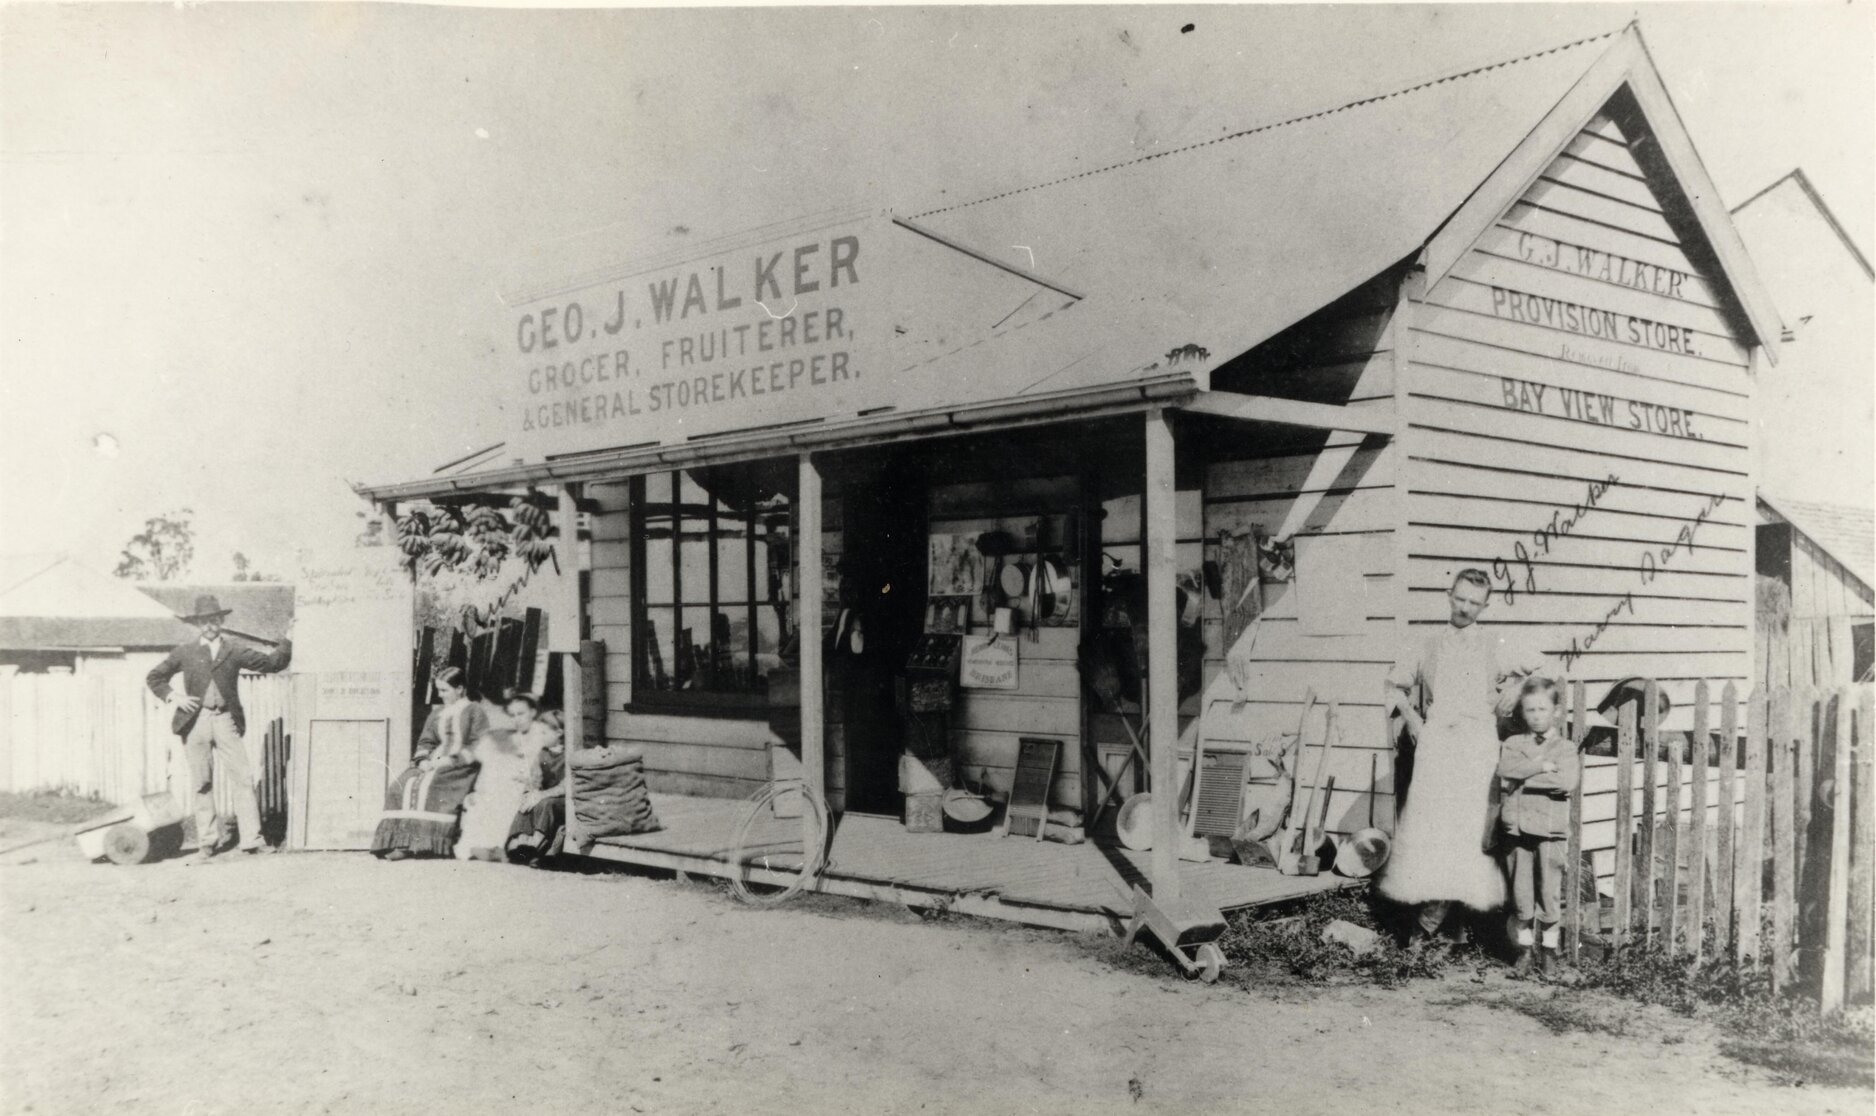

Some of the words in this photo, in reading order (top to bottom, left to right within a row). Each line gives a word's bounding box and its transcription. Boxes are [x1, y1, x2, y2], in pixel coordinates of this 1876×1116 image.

[517, 302, 597, 353] GEO.
[648, 235, 860, 325] WALKER
[1492, 285, 1618, 340] PROVISION
[1627, 316, 1702, 356] STORE.
[661, 307, 854, 369] FRUITERER,
[649, 351, 861, 412] STOREKEEPER.
[1501, 376, 1546, 413] BAY
[1559, 387, 1615, 426] VIEW
[1629, 399, 1704, 440] STORE.
